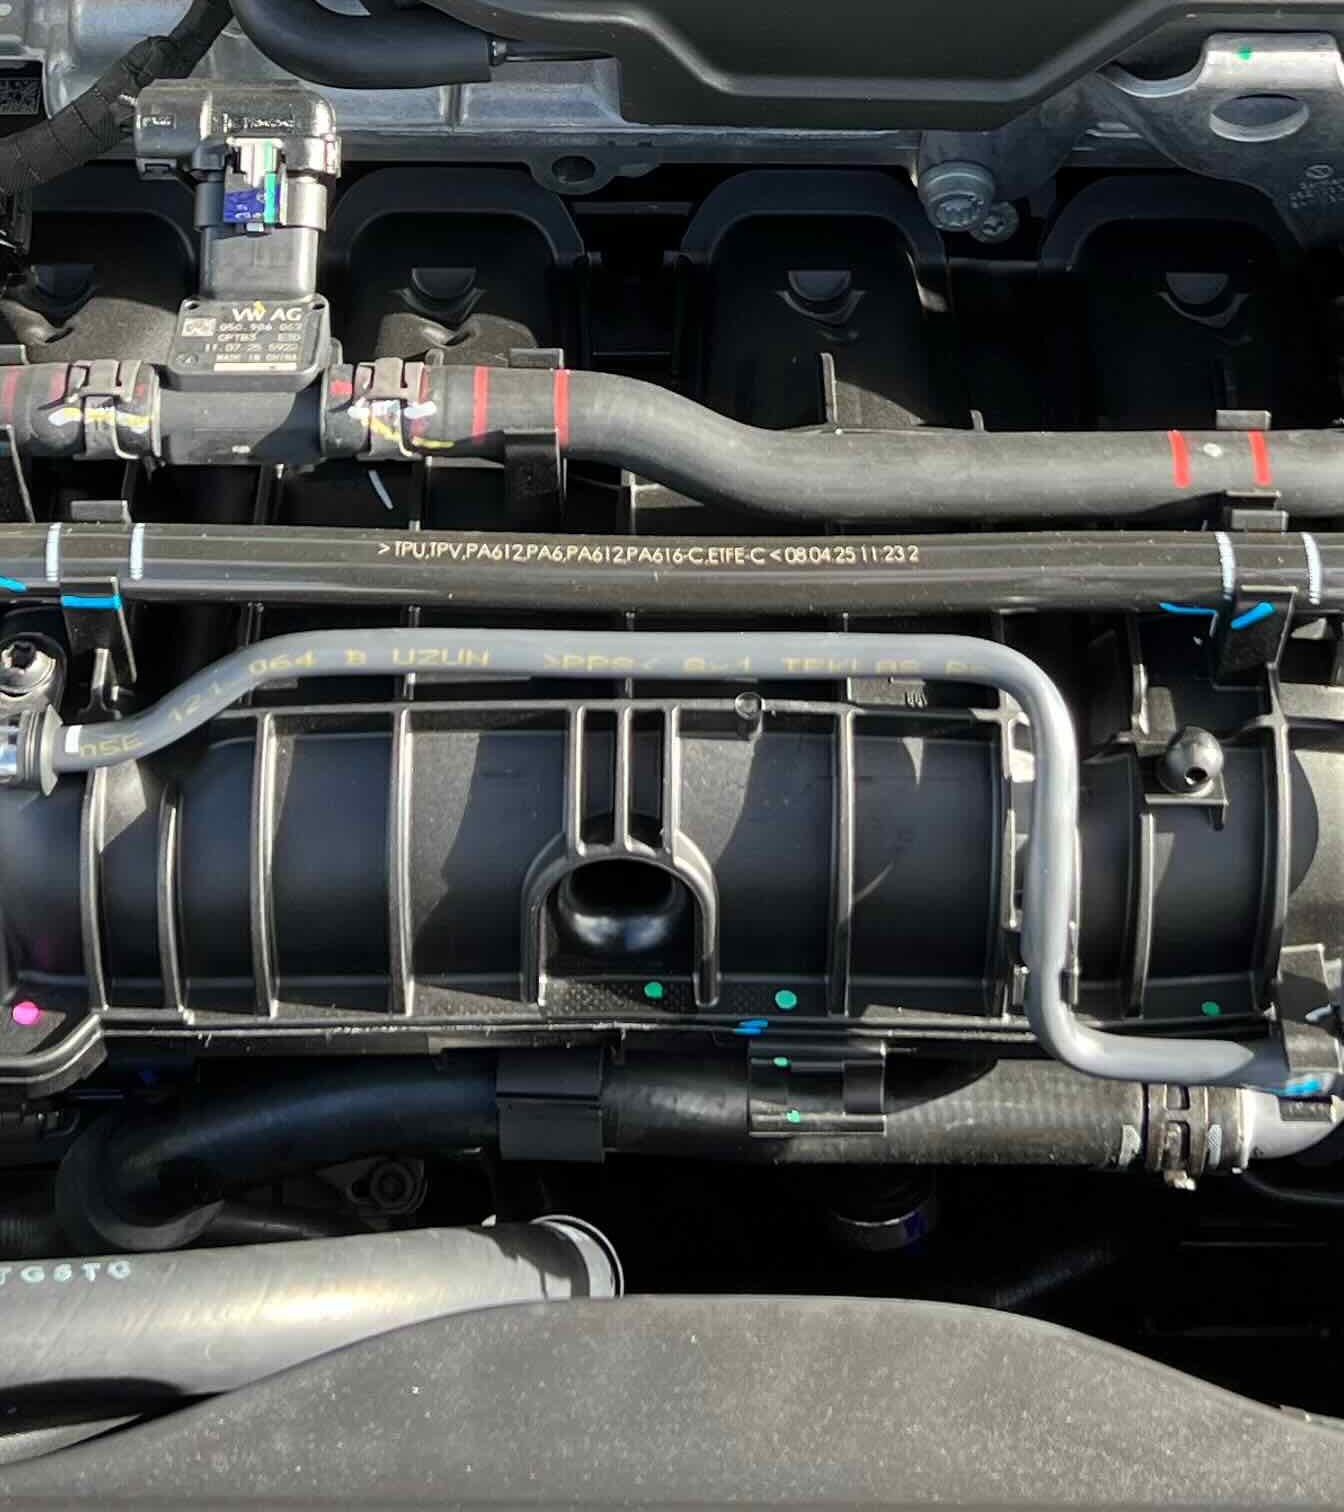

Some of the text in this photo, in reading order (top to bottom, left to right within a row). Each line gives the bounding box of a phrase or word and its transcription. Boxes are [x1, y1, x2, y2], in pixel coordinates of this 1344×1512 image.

[231, 307, 303, 321] VW AG
[265, 353, 297, 361] CHINA
[248, 649, 318, 676] 064
[391, 648, 493, 667] UZUN
